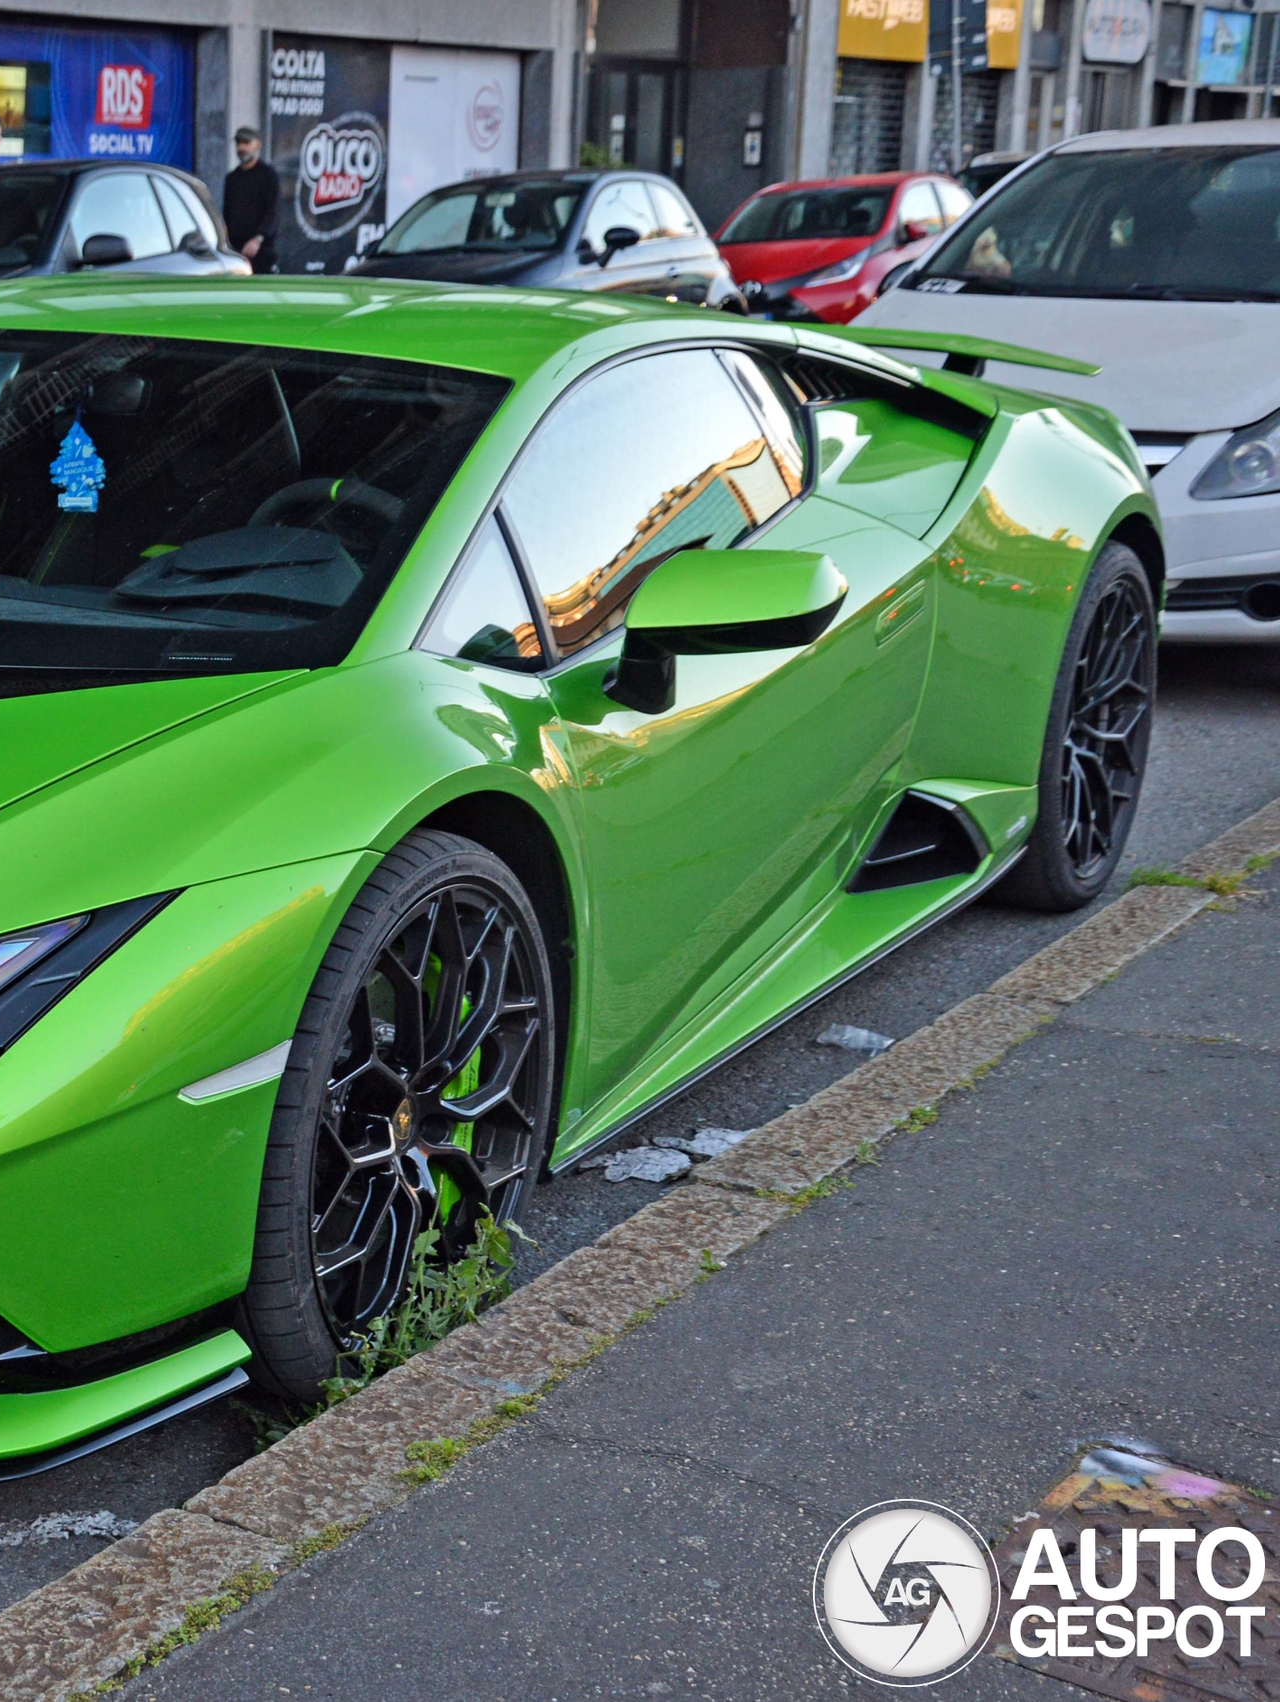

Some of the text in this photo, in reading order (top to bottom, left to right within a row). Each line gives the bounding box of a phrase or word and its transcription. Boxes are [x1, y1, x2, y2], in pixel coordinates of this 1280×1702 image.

[271, 48, 325, 79] COLTA
[102, 67, 143, 115] RDS
[89, 132, 154, 155] SOCIAL TV
[319, 175, 360, 200] RADIO
